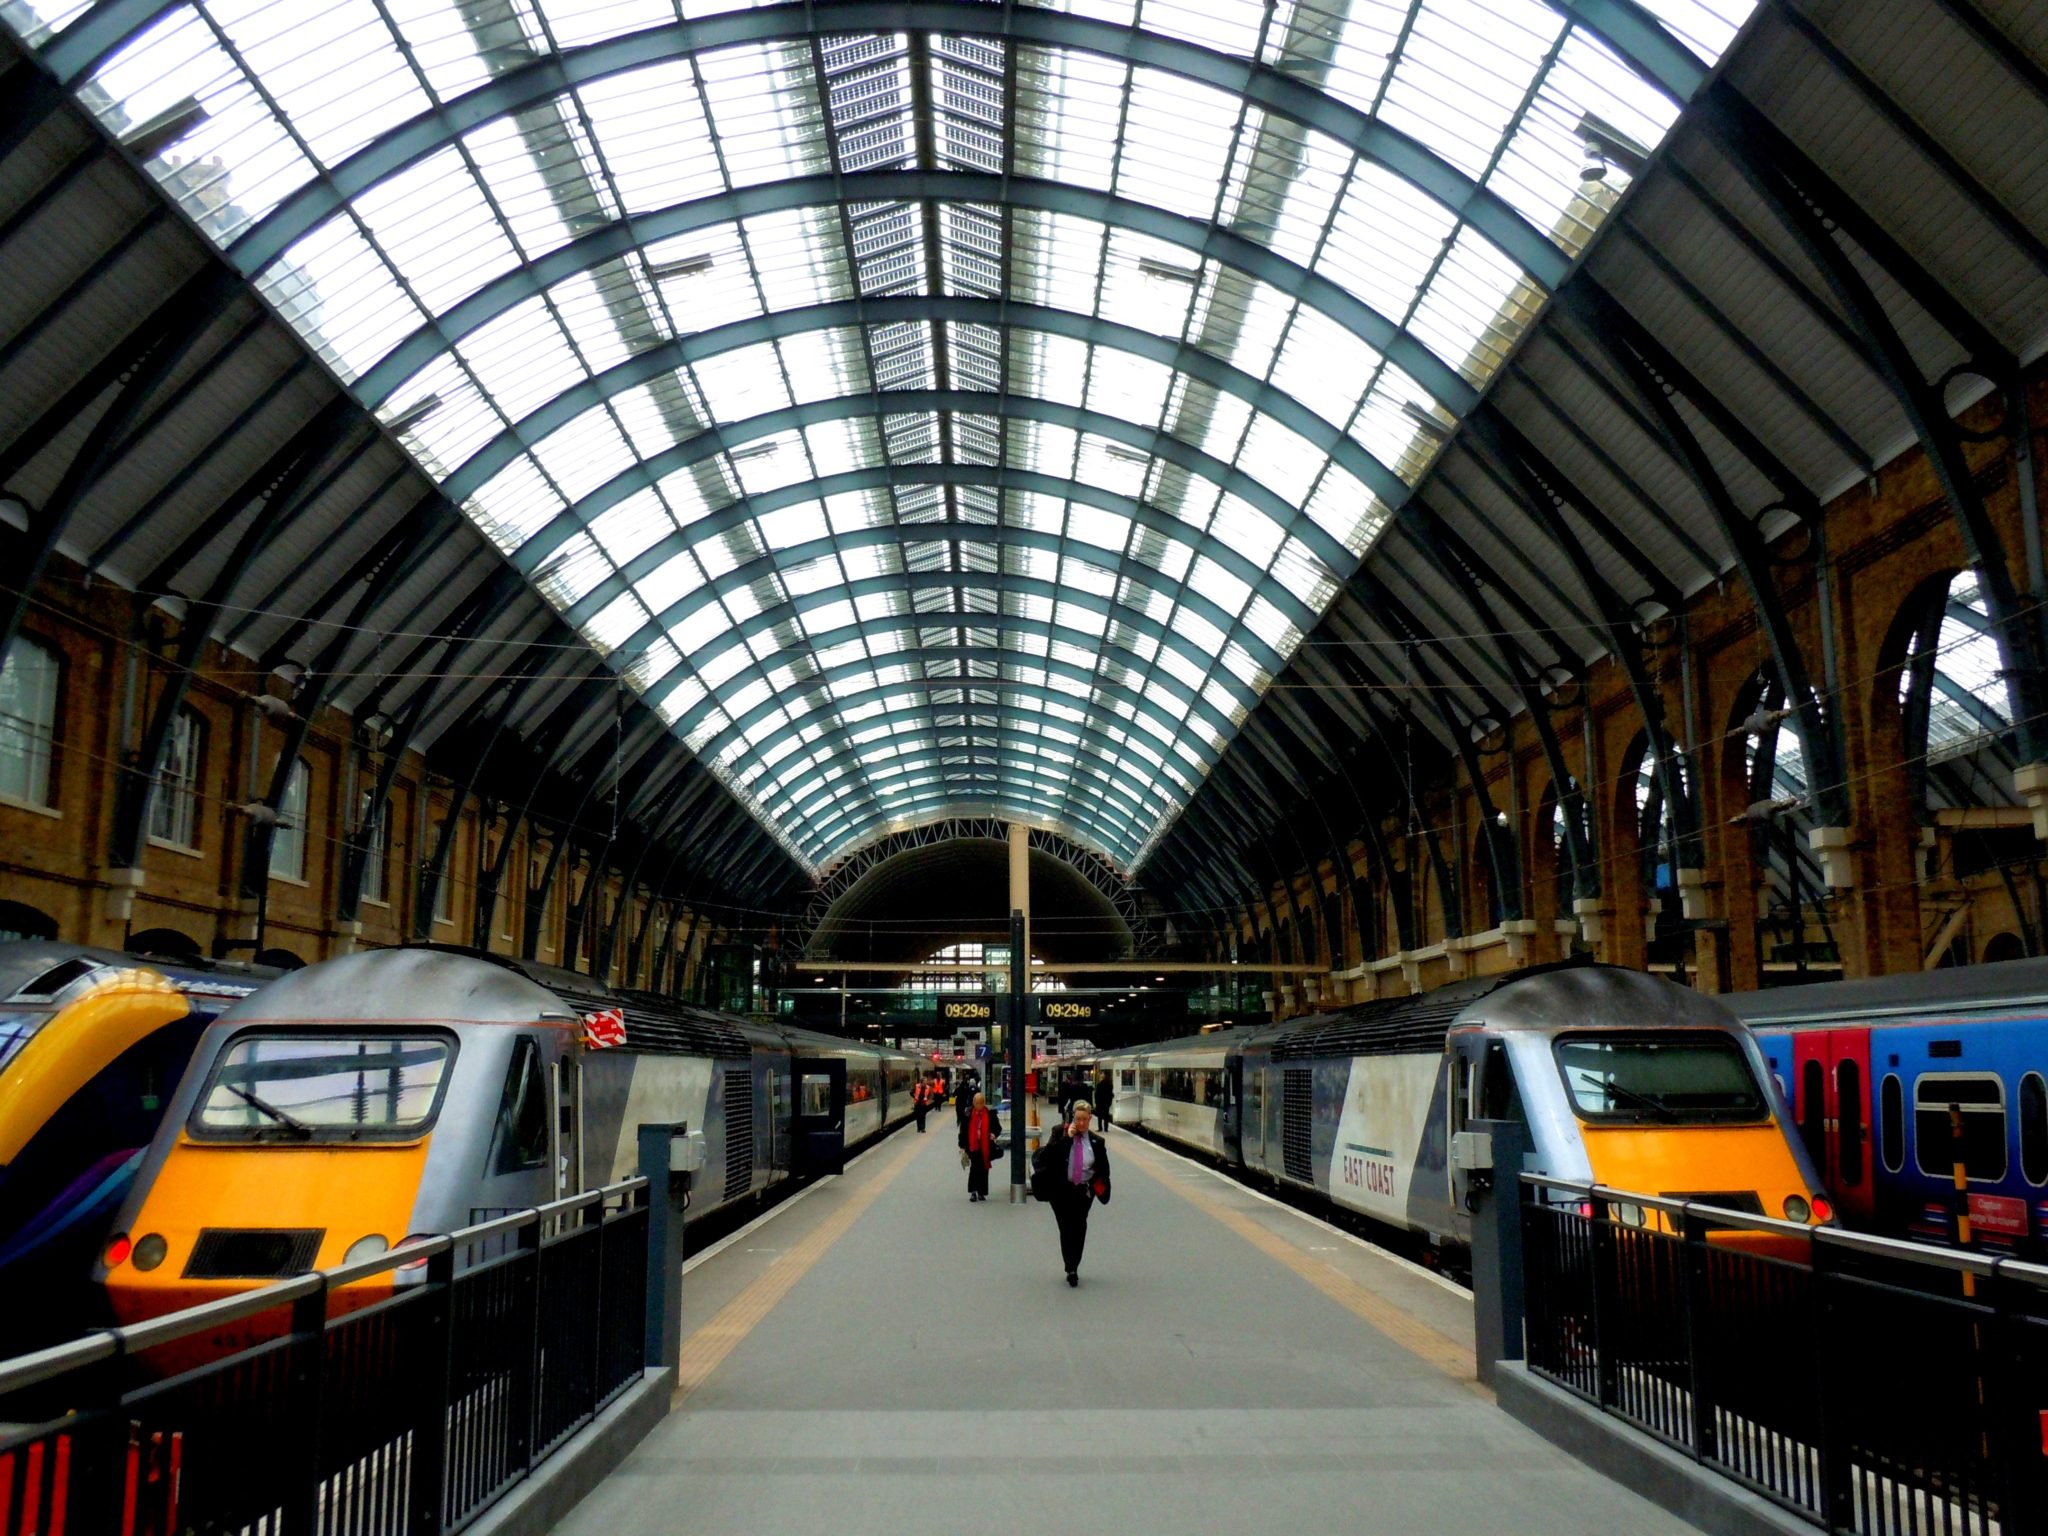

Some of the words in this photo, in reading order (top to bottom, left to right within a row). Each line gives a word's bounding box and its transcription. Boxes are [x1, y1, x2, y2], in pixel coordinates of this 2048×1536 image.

[979, 1046, 987, 1057] 7
[1344, 1155, 1363, 1187] EAST
[1366, 1160, 1394, 1197] COAST
